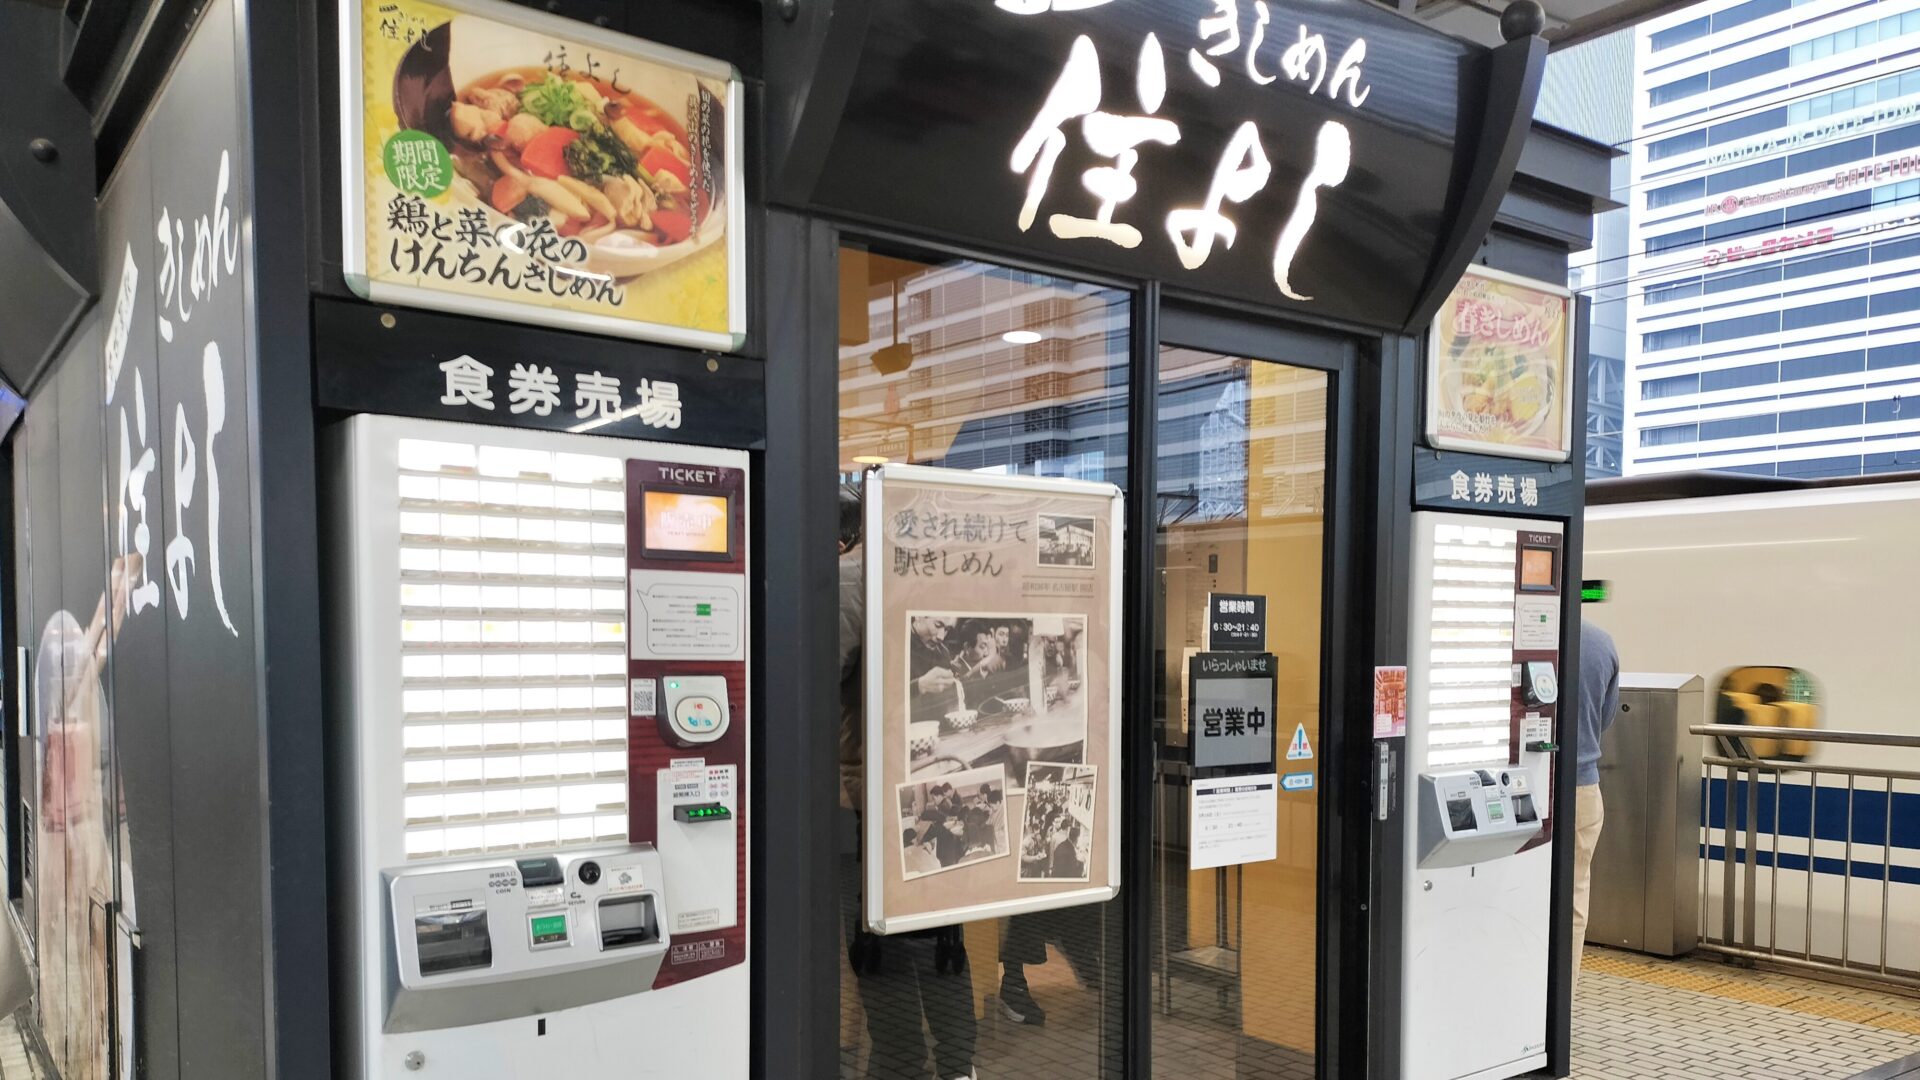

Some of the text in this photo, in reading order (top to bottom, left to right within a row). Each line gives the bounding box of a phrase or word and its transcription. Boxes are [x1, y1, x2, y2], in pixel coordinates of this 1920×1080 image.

[1189, 0, 1371, 108] きしめん
[393, 139, 439, 167] 期間
[1010, 32, 1352, 301] 住よし
[398, 165, 443, 192] 限定
[158, 149, 238, 343] きしめん
[387, 193, 588, 264] 鶏と菜の花の
[391, 239, 623, 306] けんちんきしめん
[439, 354, 682, 430] 食券売場
[117, 340, 238, 637] 住よし
[658, 466, 717, 484] TICKET
[1451, 469, 1538, 507] 食券売場
[894, 508, 1029, 544] 愛され続けて
[1528, 533, 1552, 544] TICKET
[893, 546, 1003, 577] 駅きしめん
[1219, 600, 1255, 615] 営業時間
[1202, 658, 1267, 673] いらっしゃいませ
[1203, 706, 1265, 738] 営業中
